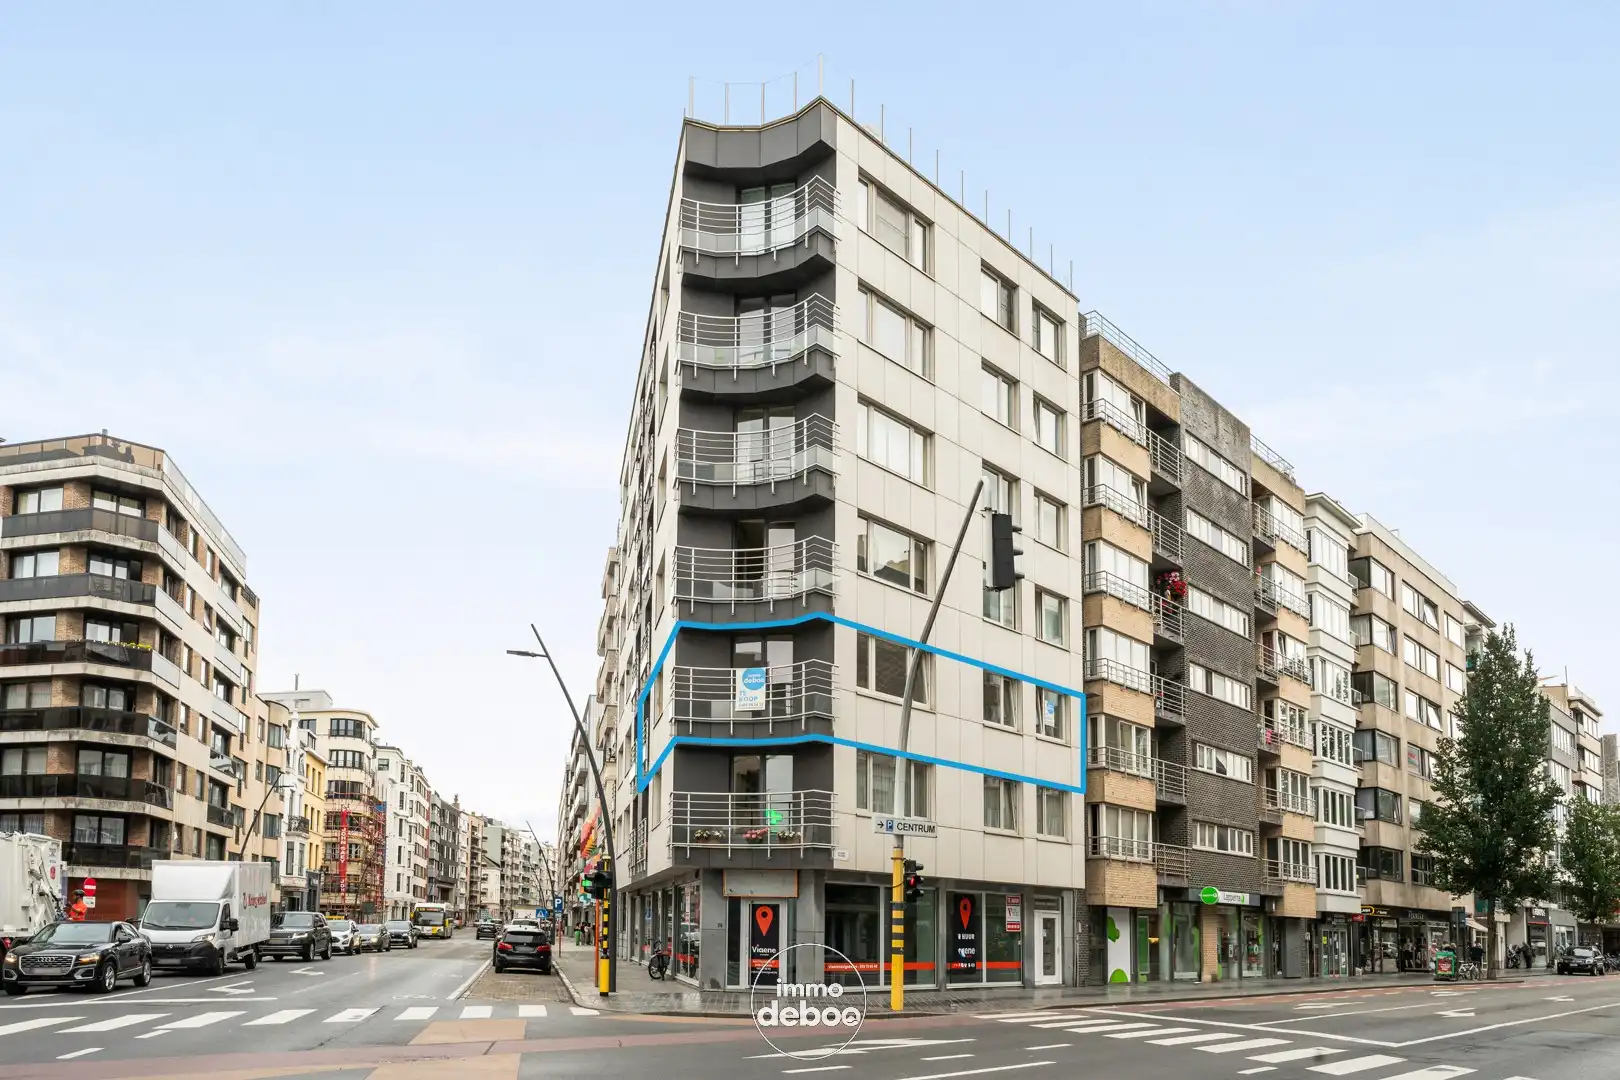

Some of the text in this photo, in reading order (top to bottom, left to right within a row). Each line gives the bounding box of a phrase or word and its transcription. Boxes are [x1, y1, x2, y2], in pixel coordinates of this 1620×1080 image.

[896, 822, 936, 833] CENTRUM
[555, 898, 562, 908] P
[751, 944, 777, 954] Viaene
